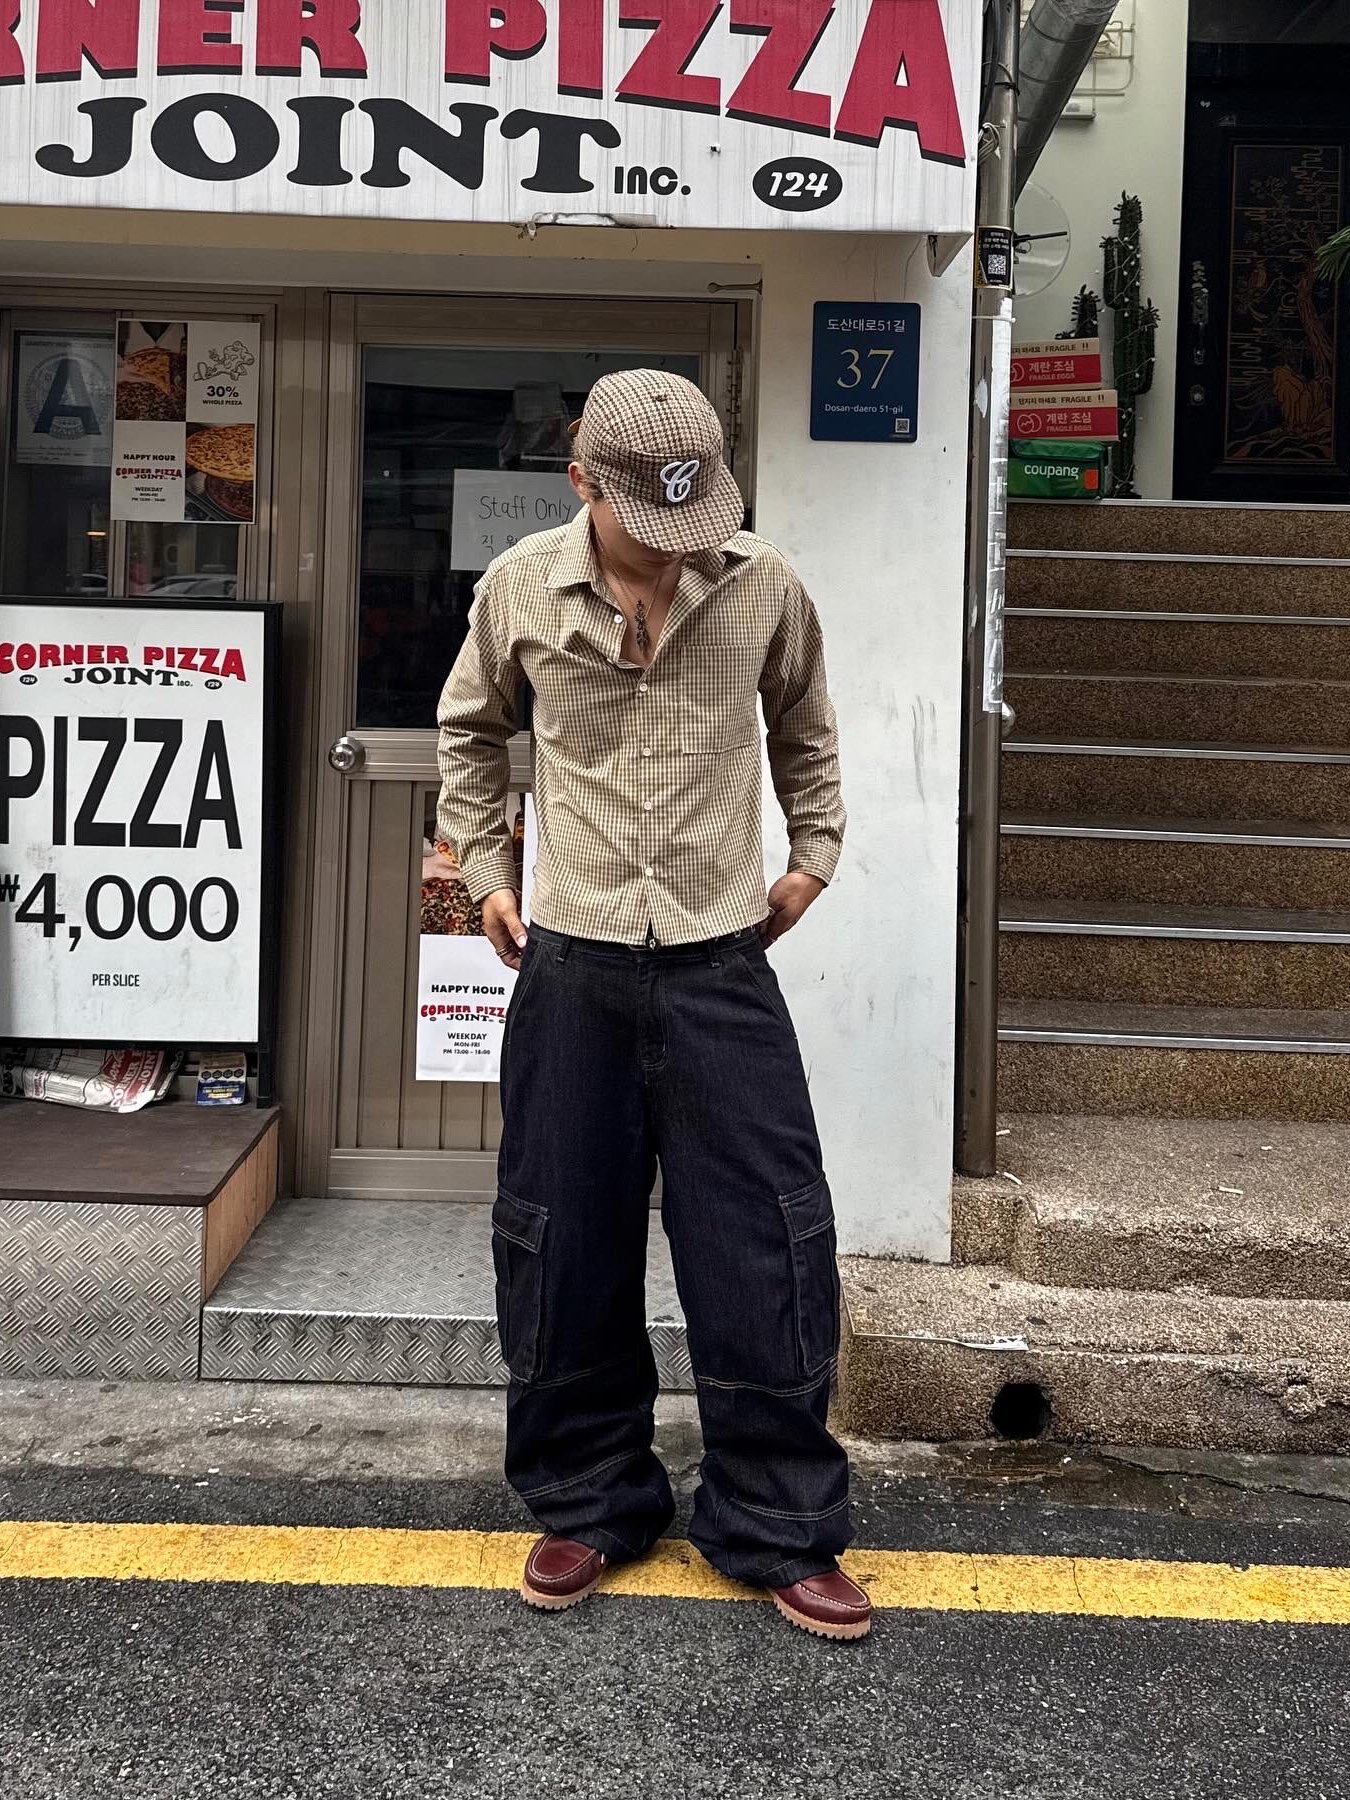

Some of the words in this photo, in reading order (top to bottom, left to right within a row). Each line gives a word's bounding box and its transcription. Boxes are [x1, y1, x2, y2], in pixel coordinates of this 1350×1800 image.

[0, 0, 368, 85] NER
[445, 0, 966, 168] PIZZA
[35, 93, 621, 193] JOINT
[769, 171, 828, 198] 124
[826, 318, 905, 333] 도산대로51길
[1045, 343, 1076, 353] FRAGILE
[836, 348, 895, 389] 37
[1053, 359, 1075, 372] 조심
[206, 385, 239, 397] 30%
[1061, 395, 1092, 404] FRAGILE
[825, 403, 878, 413] Dosan-daero
[879, 404, 903, 414] 51-gil
[1070, 411, 1092, 424] 조심
[154, 468, 183, 478] PIZZA
[1024, 464, 1080, 480] coupang
[478, 495, 527, 519] Staff
[535, 497, 573, 524] Only
[0, 642, 129, 674] CORNER
[143, 646, 246, 682] PIZZA
[64, 667, 179, 686] JOINT
[0, 715, 243, 850] PIZZA
[92, 973, 111, 986] PER
[112, 973, 140, 987] SLICE
[431, 984, 470, 994] HAPPY
[472, 985, 506, 995] HOUR
[420, 1004, 471, 1017] CORNER
[476, 1005, 507, 1019] PIZZ
[446, 1013, 490, 1022] JOINT
[447, 1032, 487, 1040] WEEKDAY
